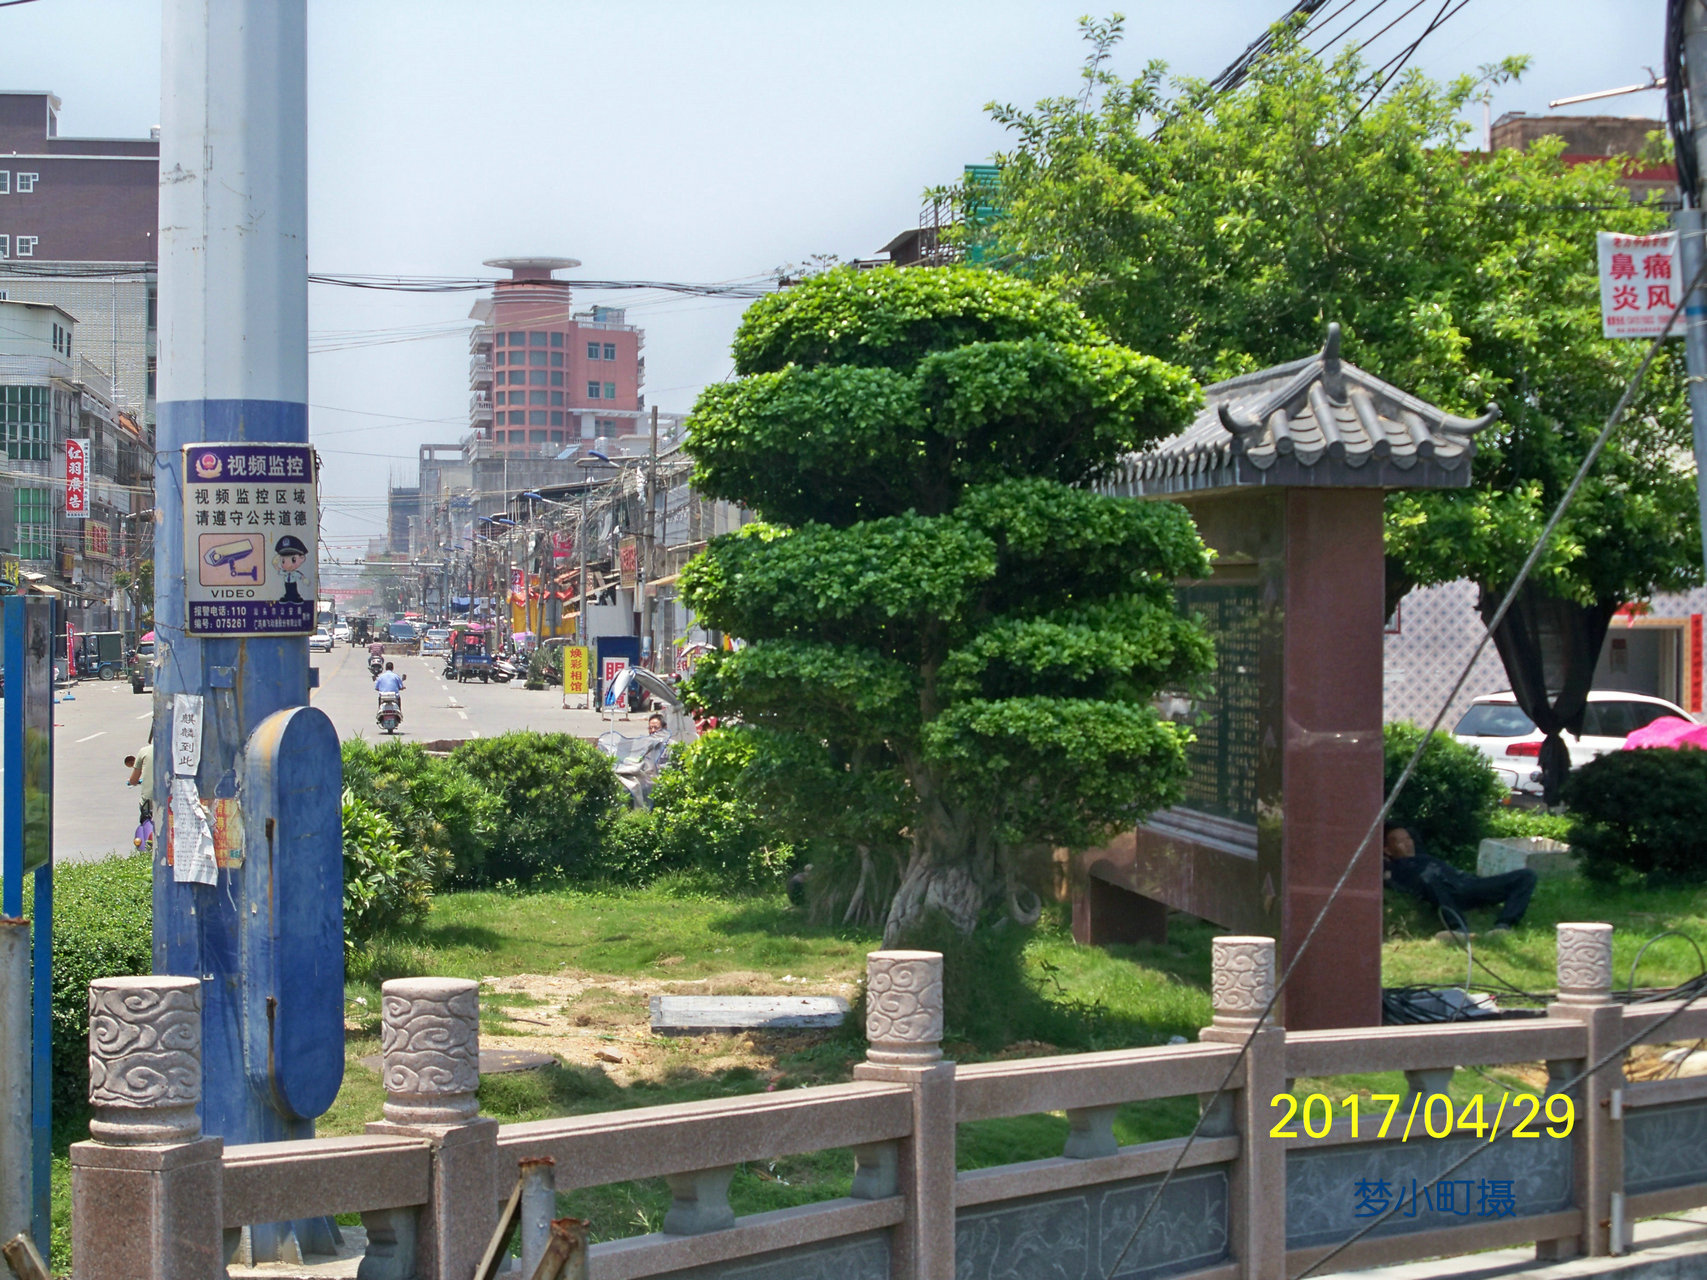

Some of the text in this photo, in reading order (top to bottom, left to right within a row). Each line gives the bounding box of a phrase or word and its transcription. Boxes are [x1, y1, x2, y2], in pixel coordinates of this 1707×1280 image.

[227, 455, 304, 477] 视频监控
[195, 488, 306, 505] 视频监控区域
[195, 510, 307, 527] 请遵守公共道德
[211, 589, 255, 598] VIDEO
